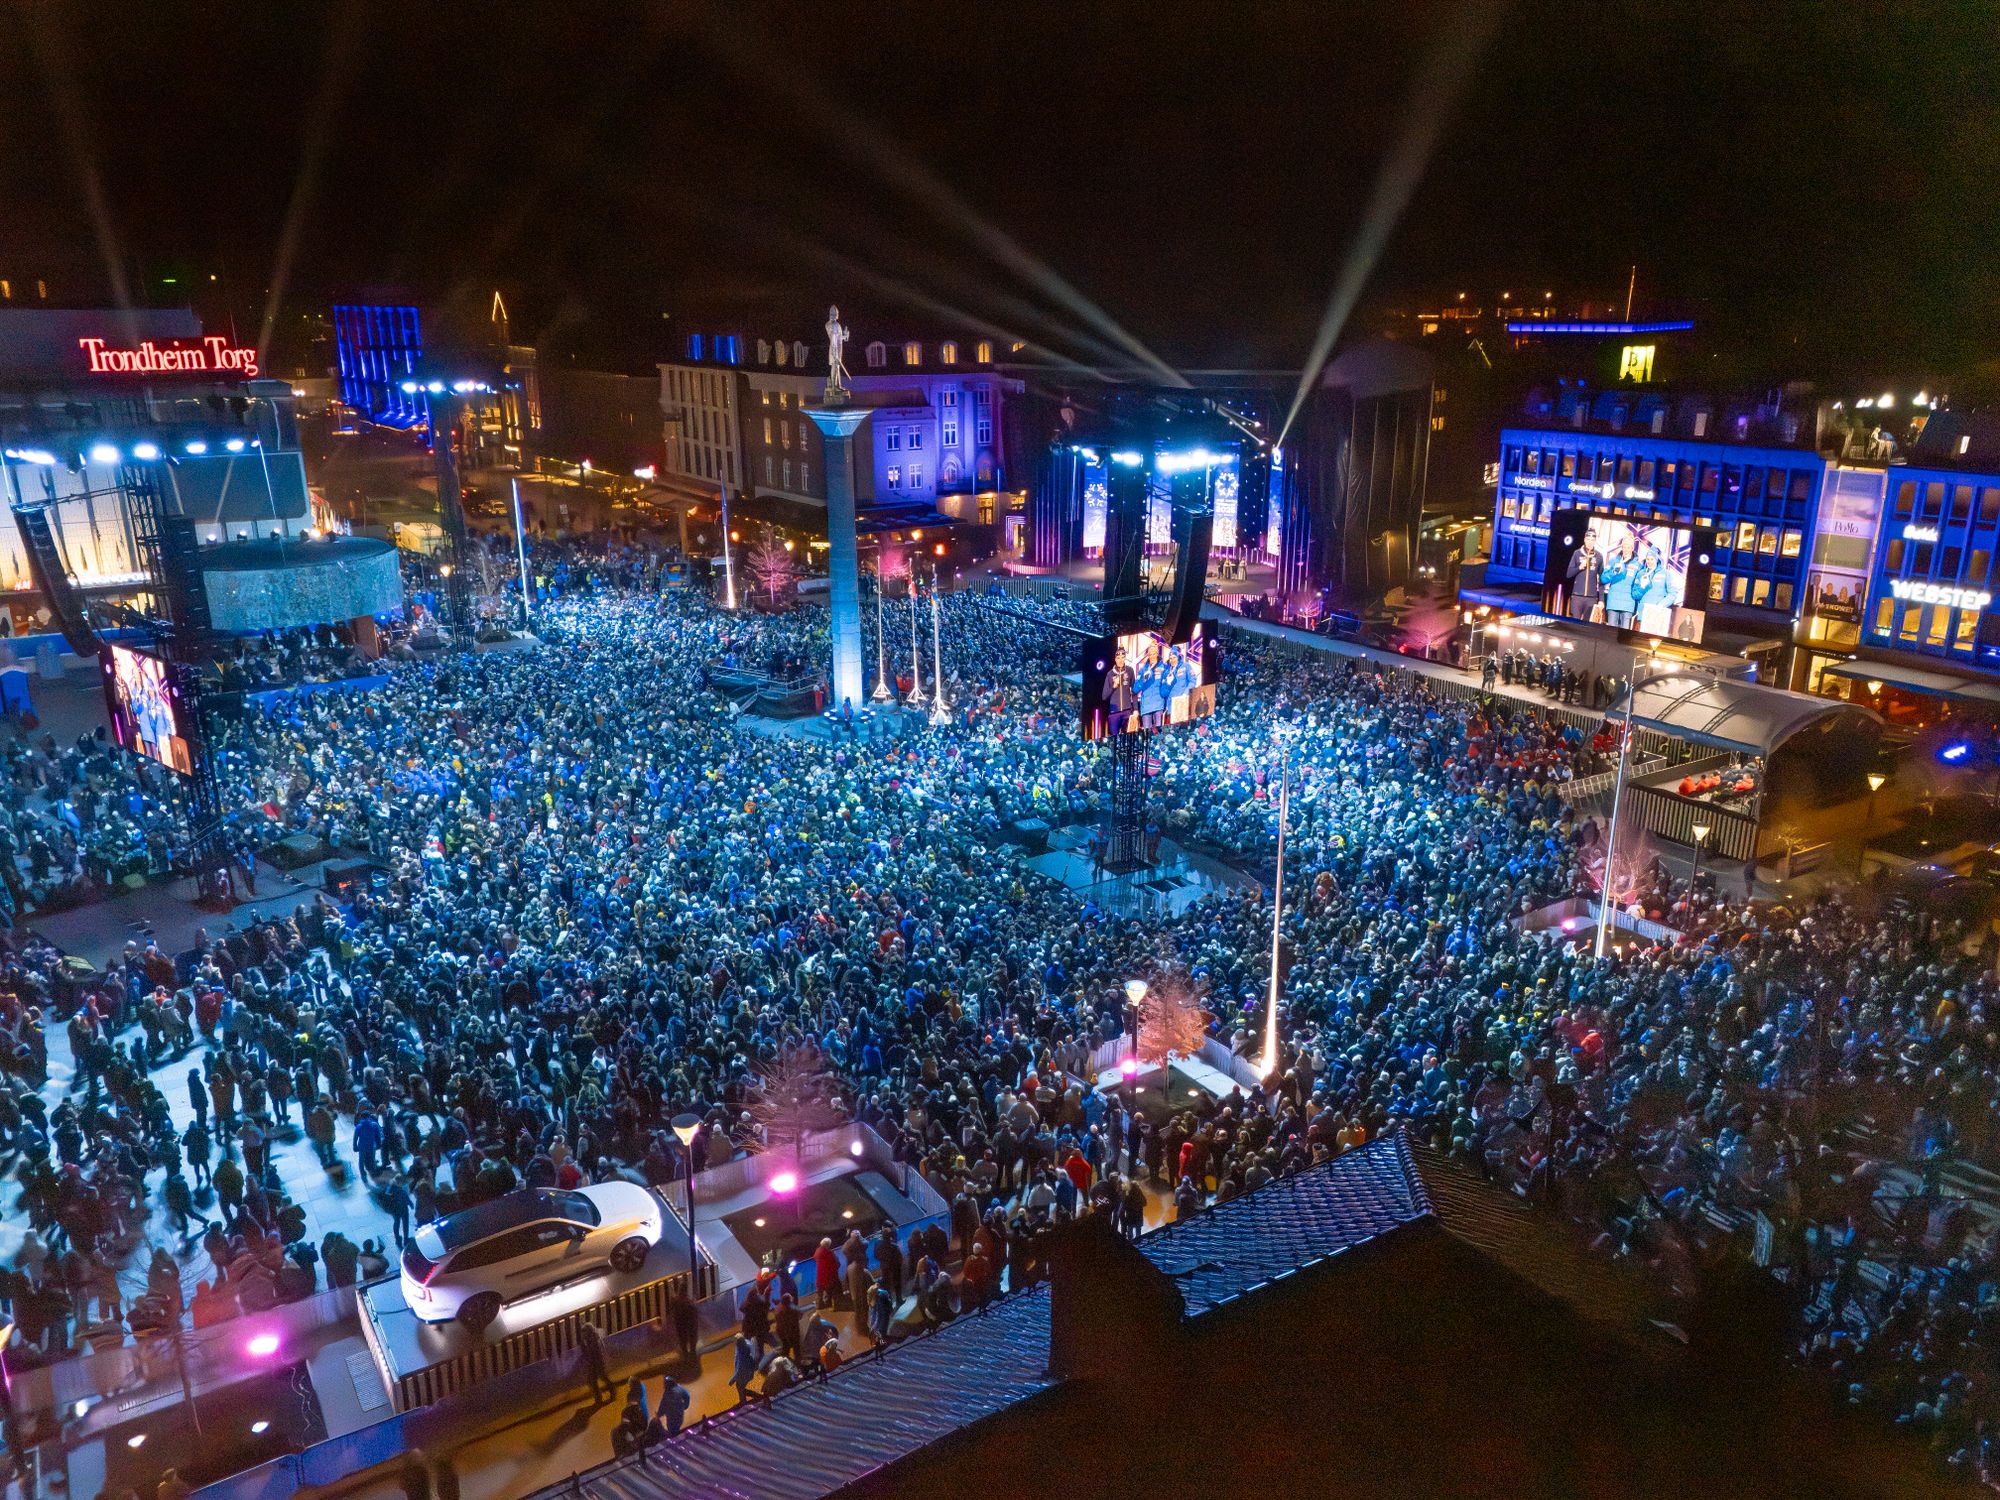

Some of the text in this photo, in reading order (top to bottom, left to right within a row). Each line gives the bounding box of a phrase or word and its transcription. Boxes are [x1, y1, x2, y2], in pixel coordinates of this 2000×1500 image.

[79, 336, 258, 376] Trondheim Torg
[1514, 477, 1547, 488] Nordea
[1890, 580, 1991, 611] WEBSTEP
